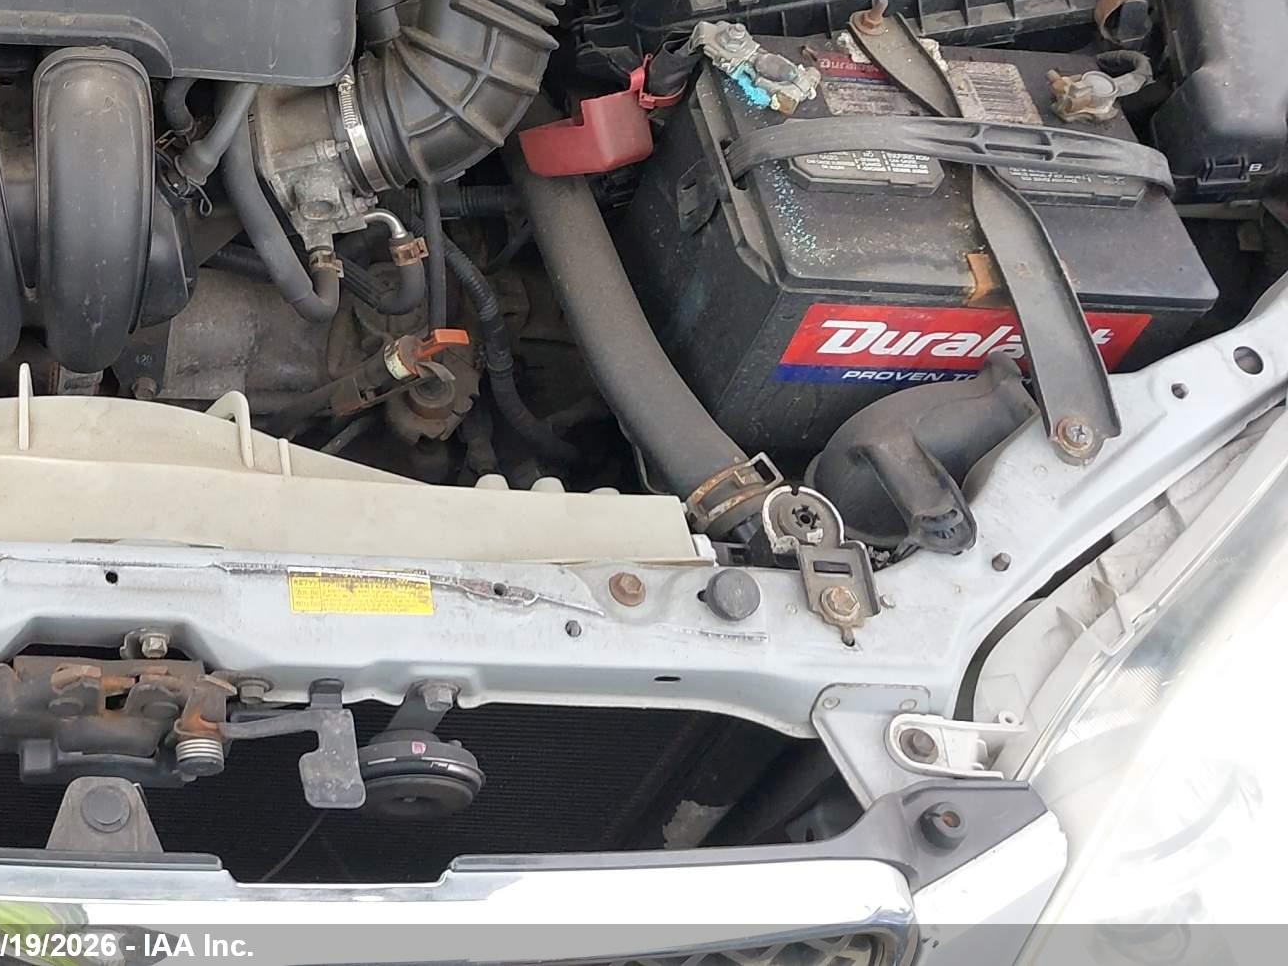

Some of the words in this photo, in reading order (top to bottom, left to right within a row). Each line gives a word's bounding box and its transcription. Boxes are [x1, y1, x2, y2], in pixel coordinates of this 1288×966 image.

[1248, 163, 1263, 172] B
[817, 321, 1114, 359] Duralat
[841, 370, 948, 383] PROVEN
